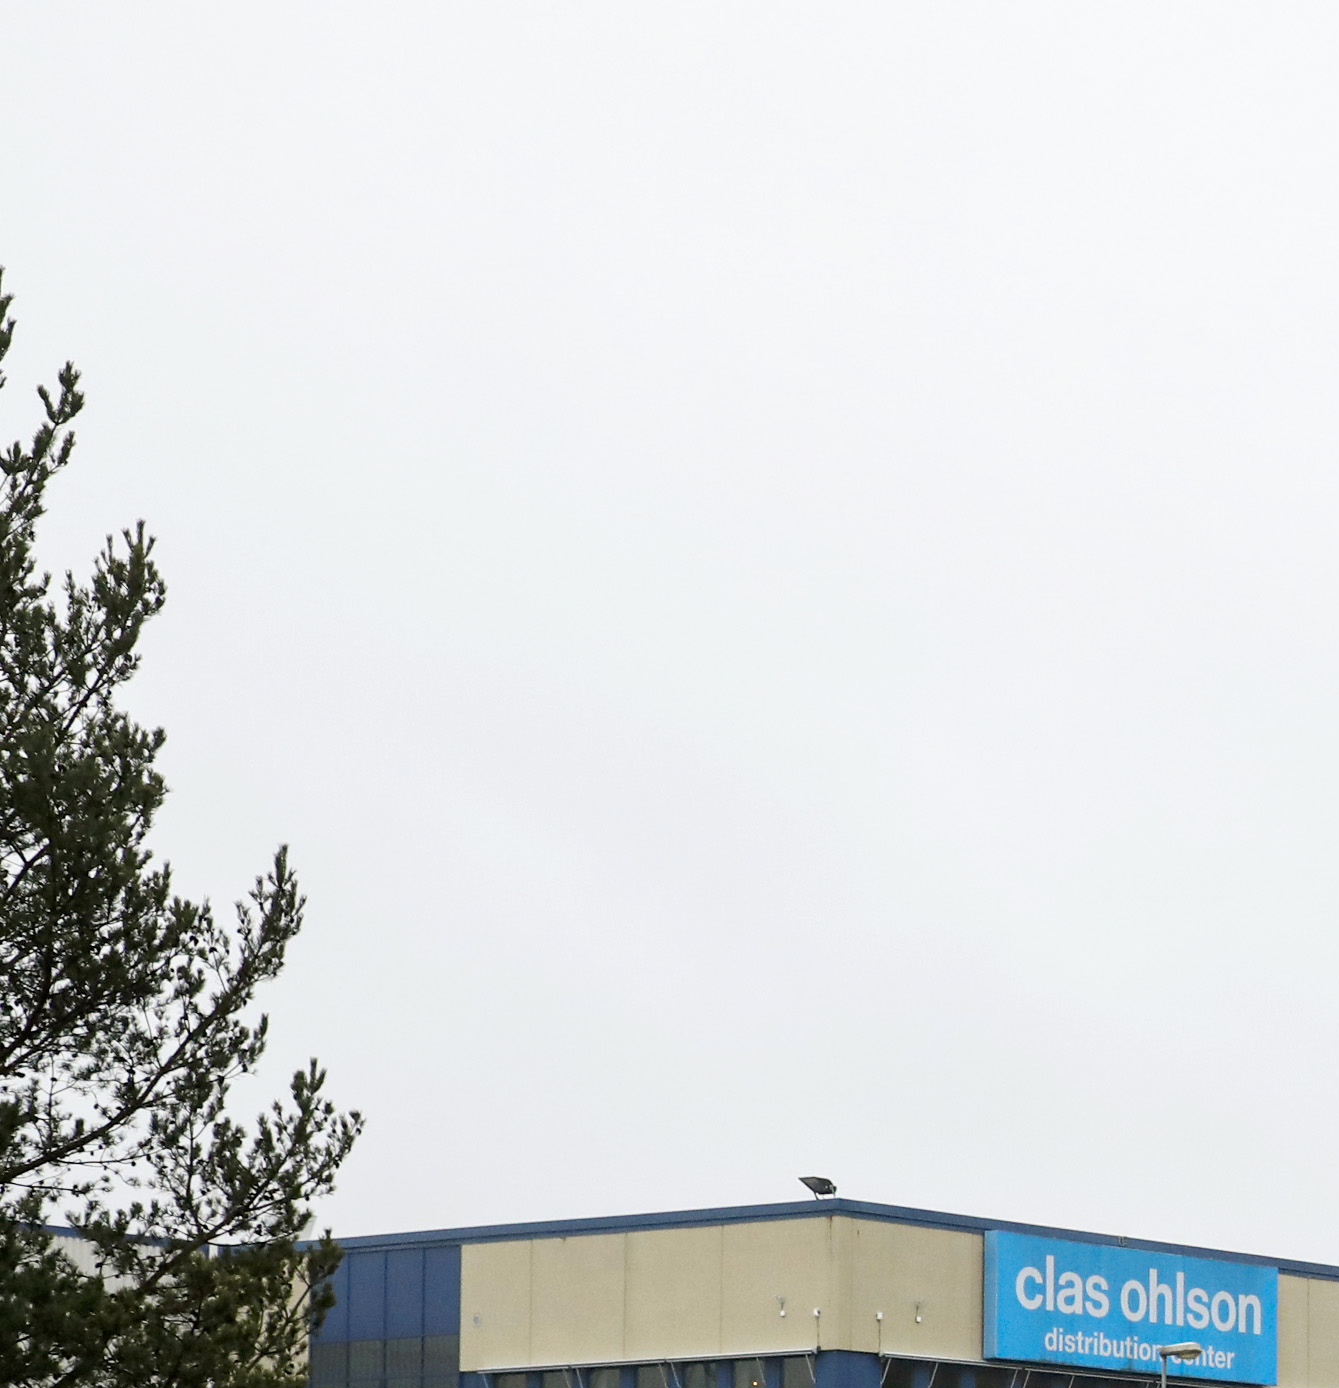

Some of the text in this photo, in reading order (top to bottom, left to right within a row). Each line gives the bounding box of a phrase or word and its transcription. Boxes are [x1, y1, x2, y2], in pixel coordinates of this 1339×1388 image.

[1015, 1255, 1262, 1335] clas ohlson
[1044, 1327, 1163, 1362] distribution
